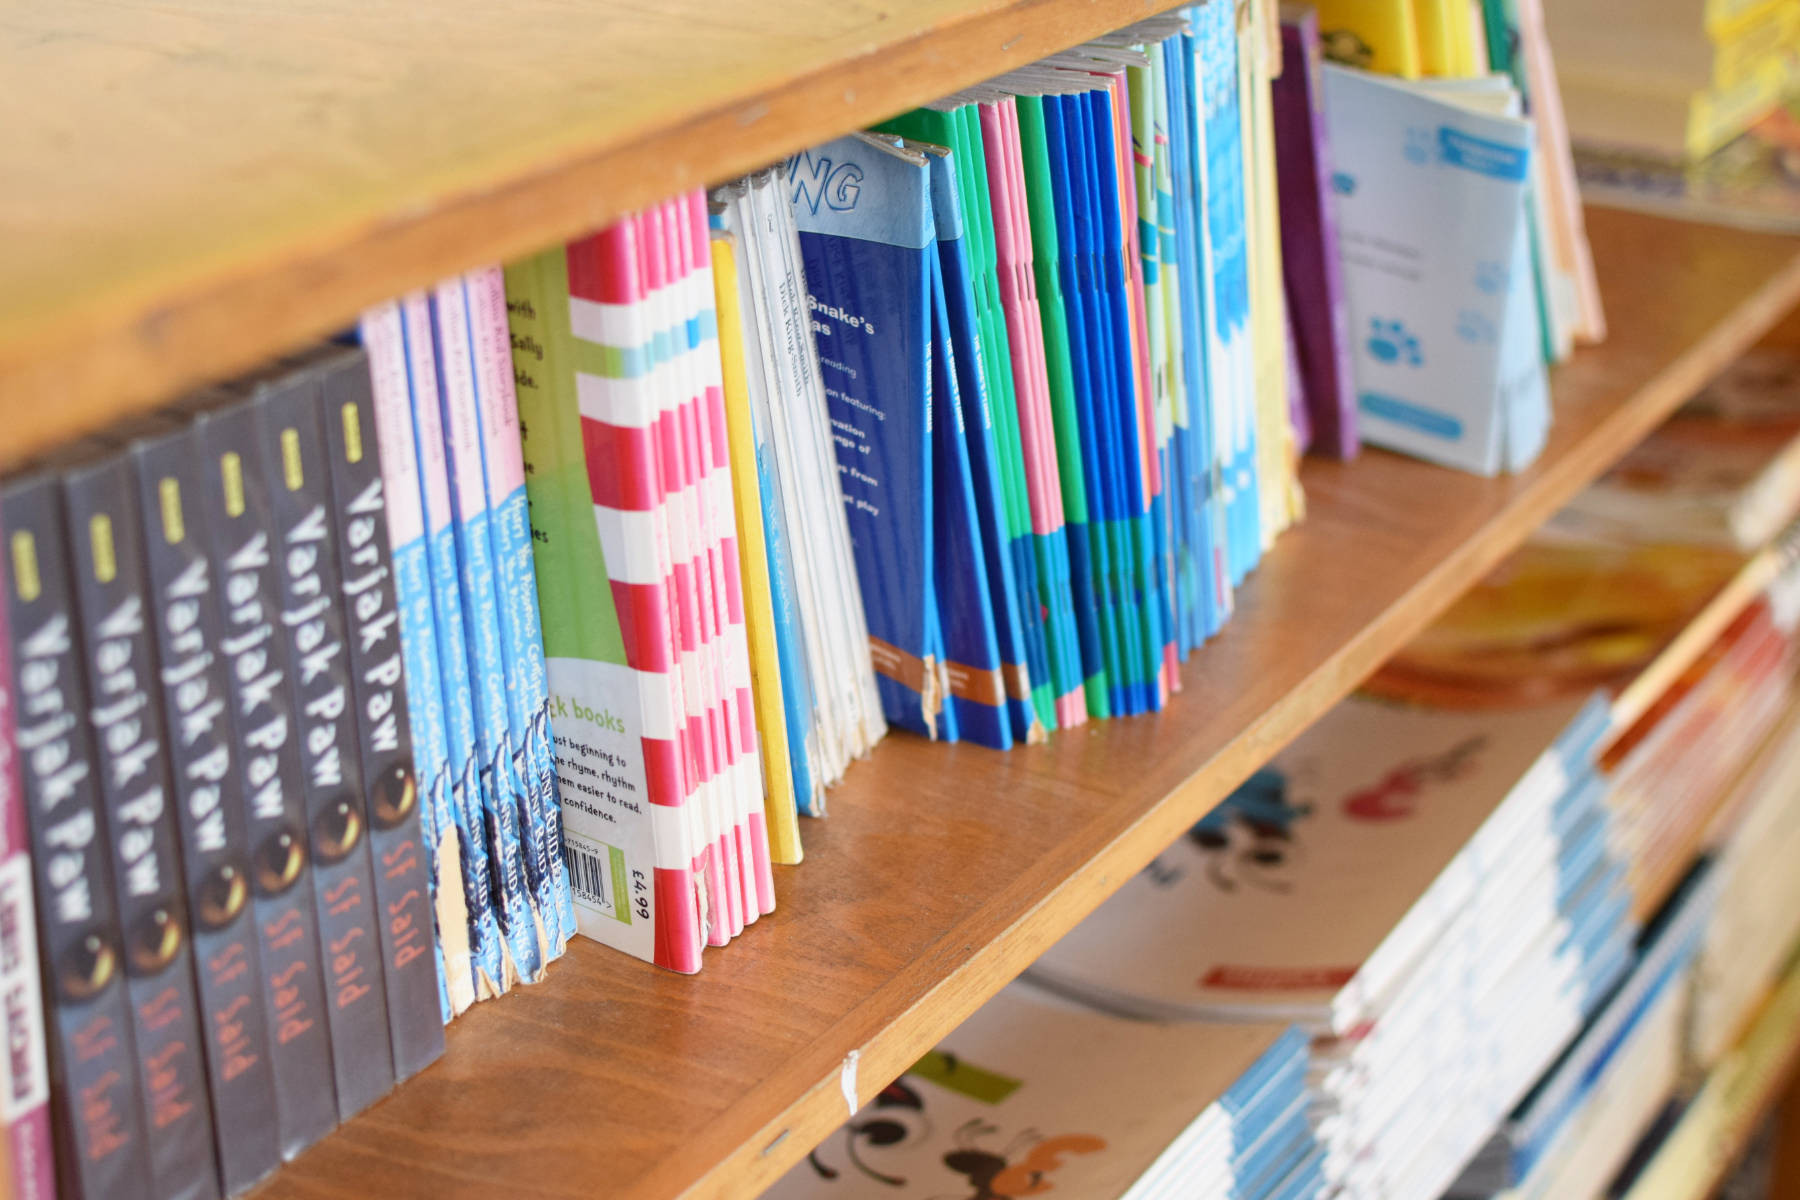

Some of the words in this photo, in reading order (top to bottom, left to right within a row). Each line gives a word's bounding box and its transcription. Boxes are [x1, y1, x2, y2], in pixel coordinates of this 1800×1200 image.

[779, 281, 790, 317] Dick
[807, 294, 876, 336] Snake's
[820, 356, 857, 380] reading
[858, 444, 871, 456] of
[850, 466, 878, 487] from
[856, 499, 880, 517] play
[342, 477, 398, 654] Varjak
[517, 542, 532, 569] the
[281, 504, 342, 685] Varjak
[220, 531, 283, 716] Varjak
[162, 556, 226, 746] Varjak
[18, 612, 89, 812] Varjak
[91, 595, 158, 789] Varjak
[364, 653, 400, 753] Paw
[571, 697, 626, 734] books
[305, 685, 346, 787] Paw
[568, 738, 615, 768] beginning
[616, 755, 627, 768] to
[246, 714, 288, 819] Paw
[601, 769, 637, 793] rhythm
[186, 743, 230, 852] Paw
[563, 797, 617, 824] confidence.
[576, 782, 605, 799] easier
[607, 792, 618, 804] to
[619, 797, 642, 815] read.
[117, 785, 164, 897] Paw
[545, 809, 561, 861] REID
[44, 809, 96, 923] Paw
[505, 842, 519, 895] REID
[632, 869, 650, 920] £4.99
[388, 890, 426, 971] Said
